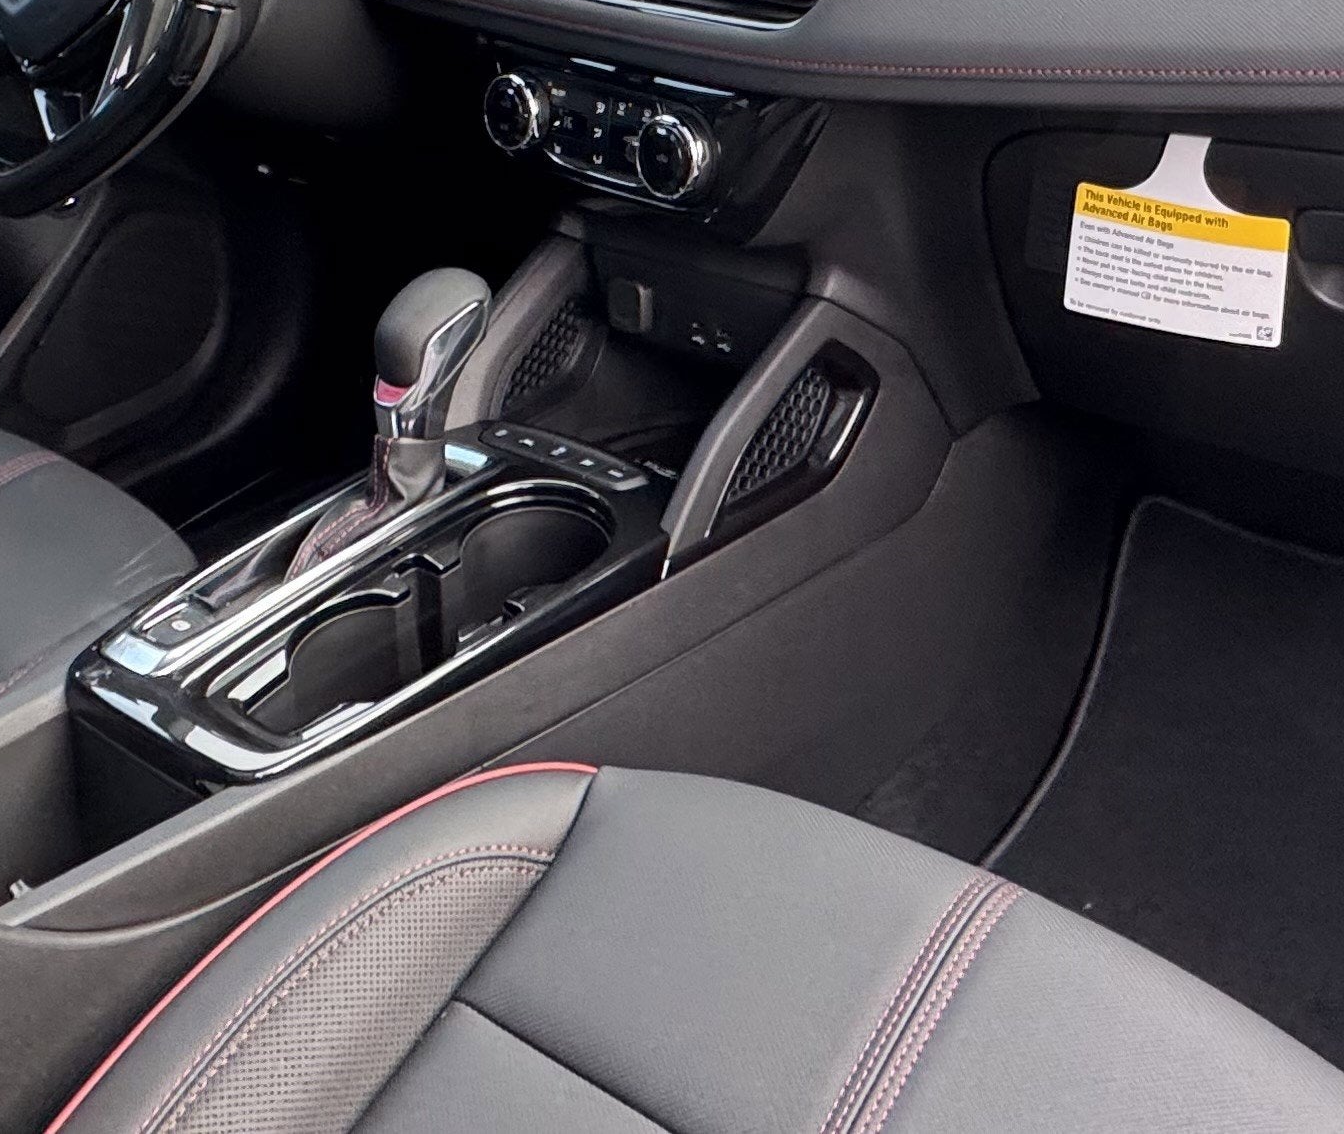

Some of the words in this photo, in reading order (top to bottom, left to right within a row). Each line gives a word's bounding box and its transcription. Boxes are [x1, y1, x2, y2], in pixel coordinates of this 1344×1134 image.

[1082, 201, 1129, 221] Advanced
[1131, 212, 1146, 225] Air
[1148, 216, 1173, 232] Bags
[1085, 188, 1104, 203] This
[1107, 194, 1141, 211] Vehicle
[1143, 202, 1152, 213] is
[1154, 204, 1202, 224] Equipped
[1204, 217, 1229, 229] with
